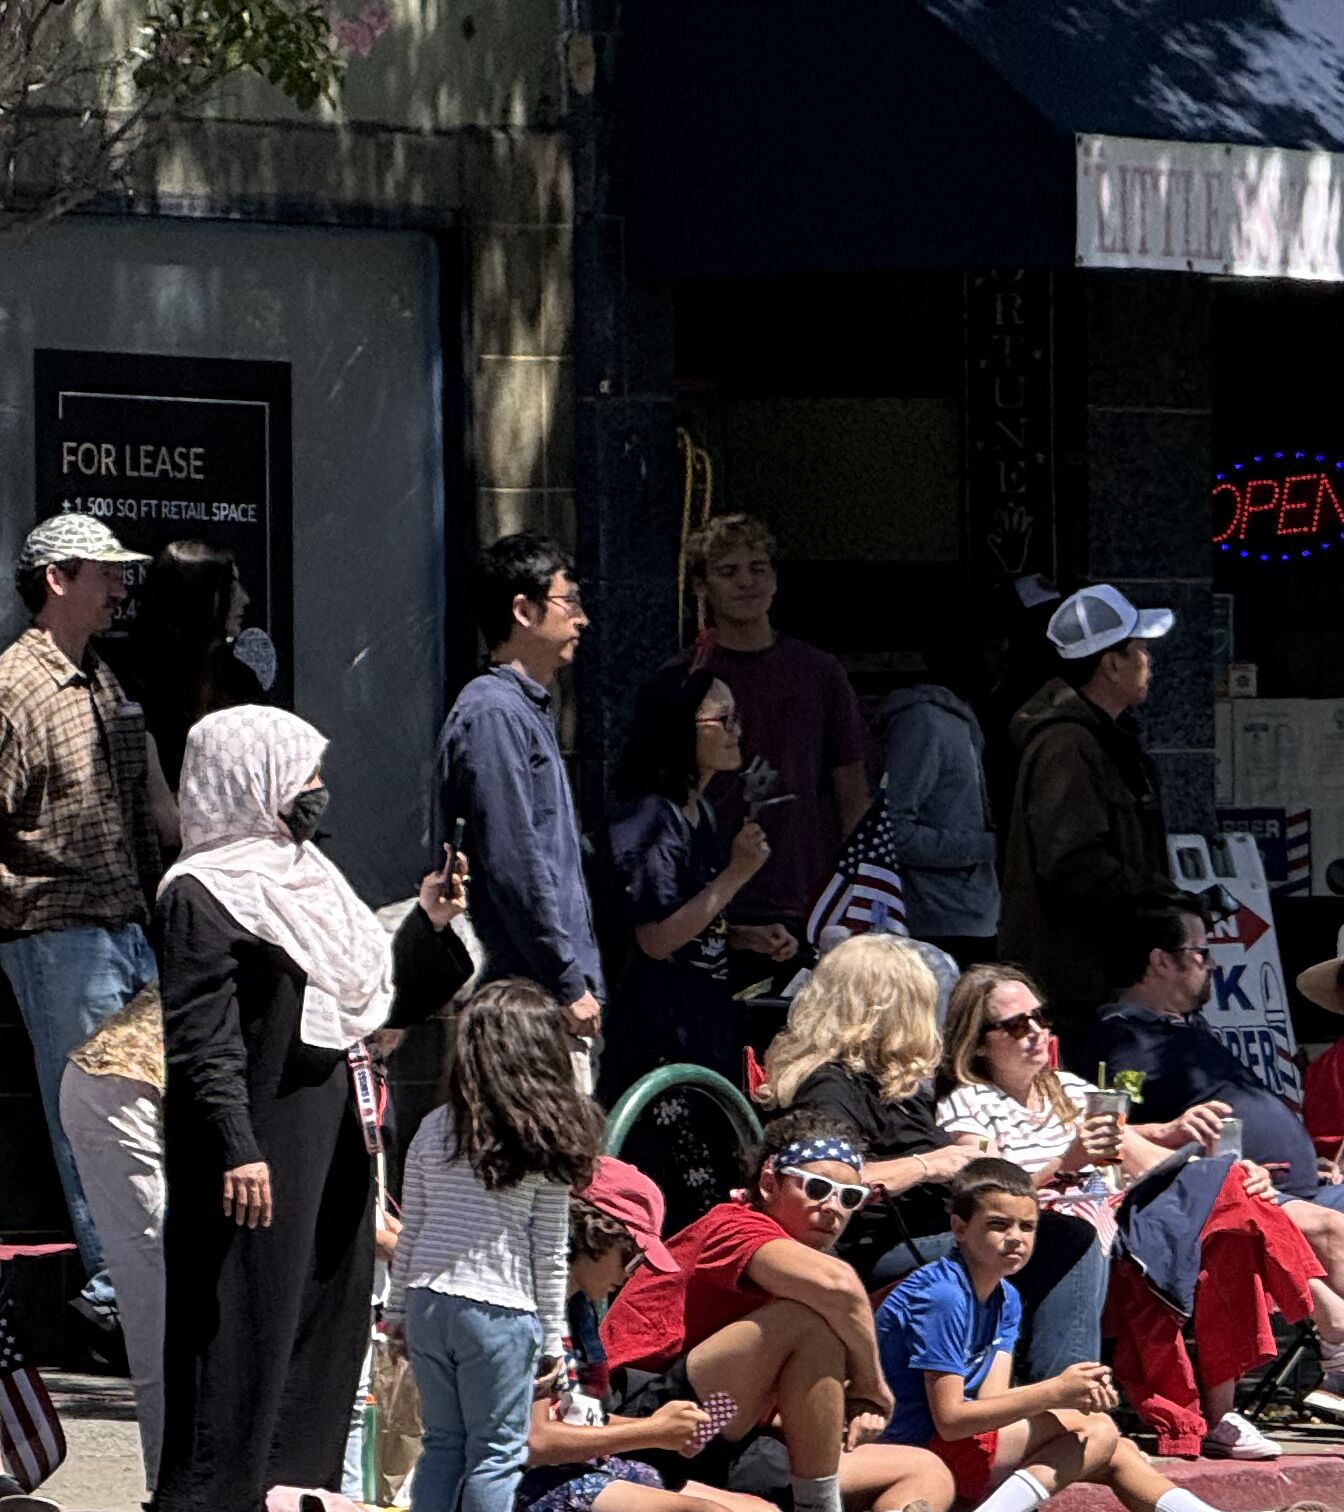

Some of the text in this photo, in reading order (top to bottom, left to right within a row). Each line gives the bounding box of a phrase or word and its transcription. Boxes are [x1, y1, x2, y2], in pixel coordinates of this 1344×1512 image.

[61, 441, 206, 481] FOR LEASE
[116, 499, 138, 521] SQ
[140, 499, 160, 519] FT
[161, 500, 210, 521] RETAIL
[211, 503, 259, 524] SPACE
